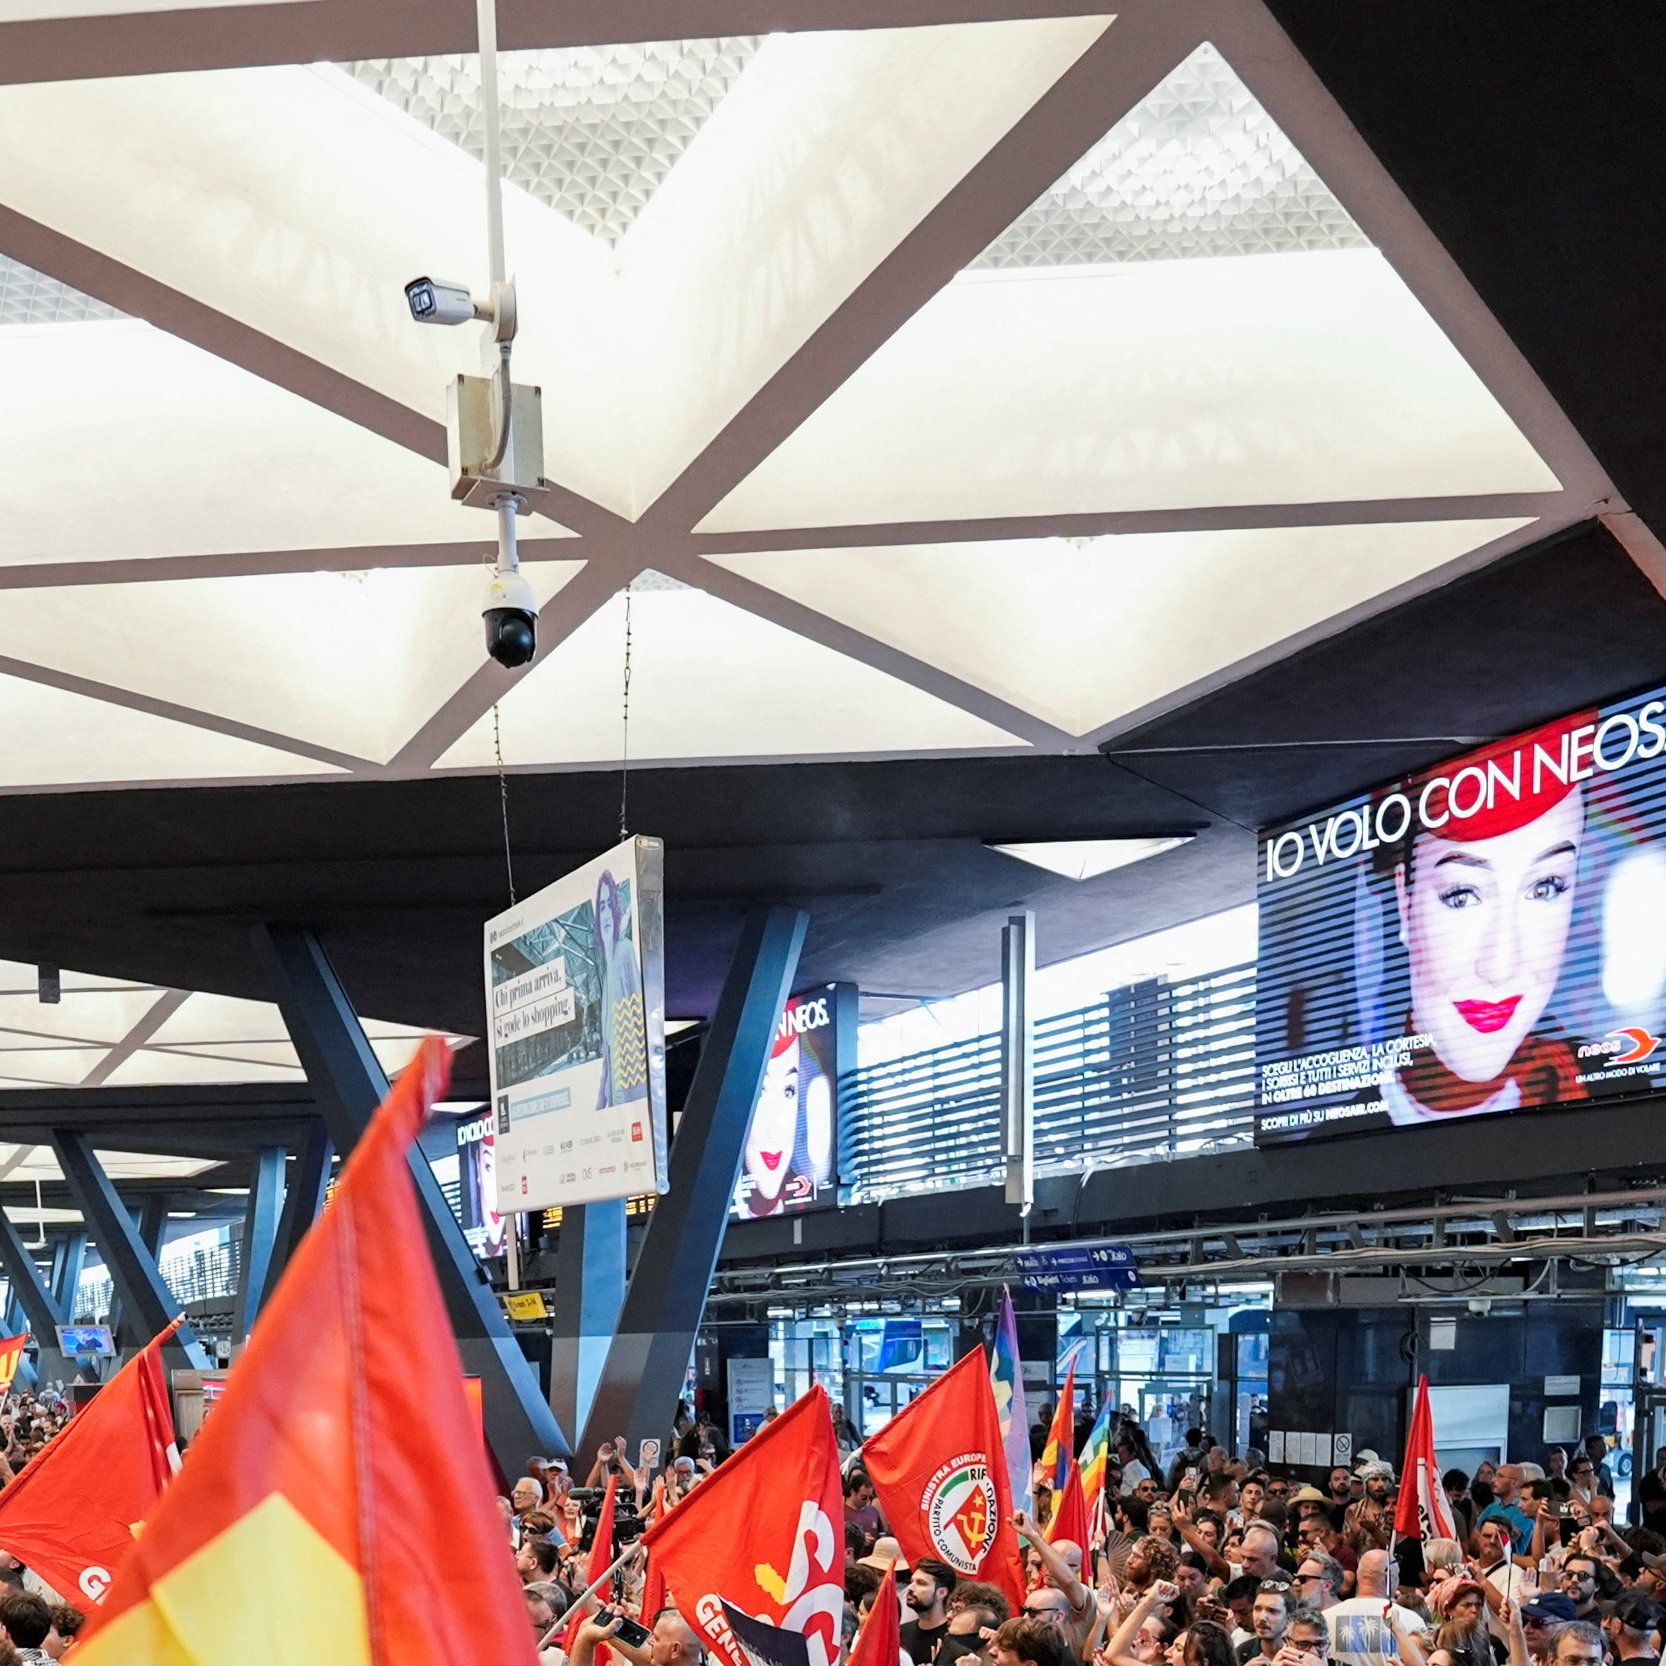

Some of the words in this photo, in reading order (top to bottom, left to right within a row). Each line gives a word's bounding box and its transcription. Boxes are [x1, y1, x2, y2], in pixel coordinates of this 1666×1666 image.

[1266, 831, 1304, 882] IO
[1308, 793, 1411, 865] VOLO
[1418, 750, 1522, 828] CON
[495, 985, 508, 1008] Chi
[509, 979, 533, 1009] prima
[496, 1019, 503, 1038] si
[503, 1013, 521, 1039] gode
[522, 1010, 531, 1029] lo
[1262, 1062, 1292, 1078] SCEGLI
[1372, 1043, 1385, 1056] LA
[1385, 1033, 1437, 1054] CORTESIA,
[1577, 1039, 1622, 1058] neos
[1266, 1074, 1299, 1091] SORRISI
[1307, 1067, 1332, 1082] TUTTI
[1338, 1060, 1370, 1077] SERVIZI
[1606, 1067, 1627, 1079] MODO
[1635, 1062, 1661, 1074] VOLARE
[1261, 1092, 1273, 1105] IN
[1273, 1088, 1303, 1103] OLTRE
[1303, 1085, 1317, 1098] 60
[1261, 1116, 1289, 1130] SCOPRI
[1290, 1113, 1299, 1126] DI
[1313, 1109, 1325, 1122] SU
[921, 1465, 952, 1511] SINISTRA
[932, 1498, 944, 1537] PARTITO
[937, 1538, 977, 1572] COMUNISTA
